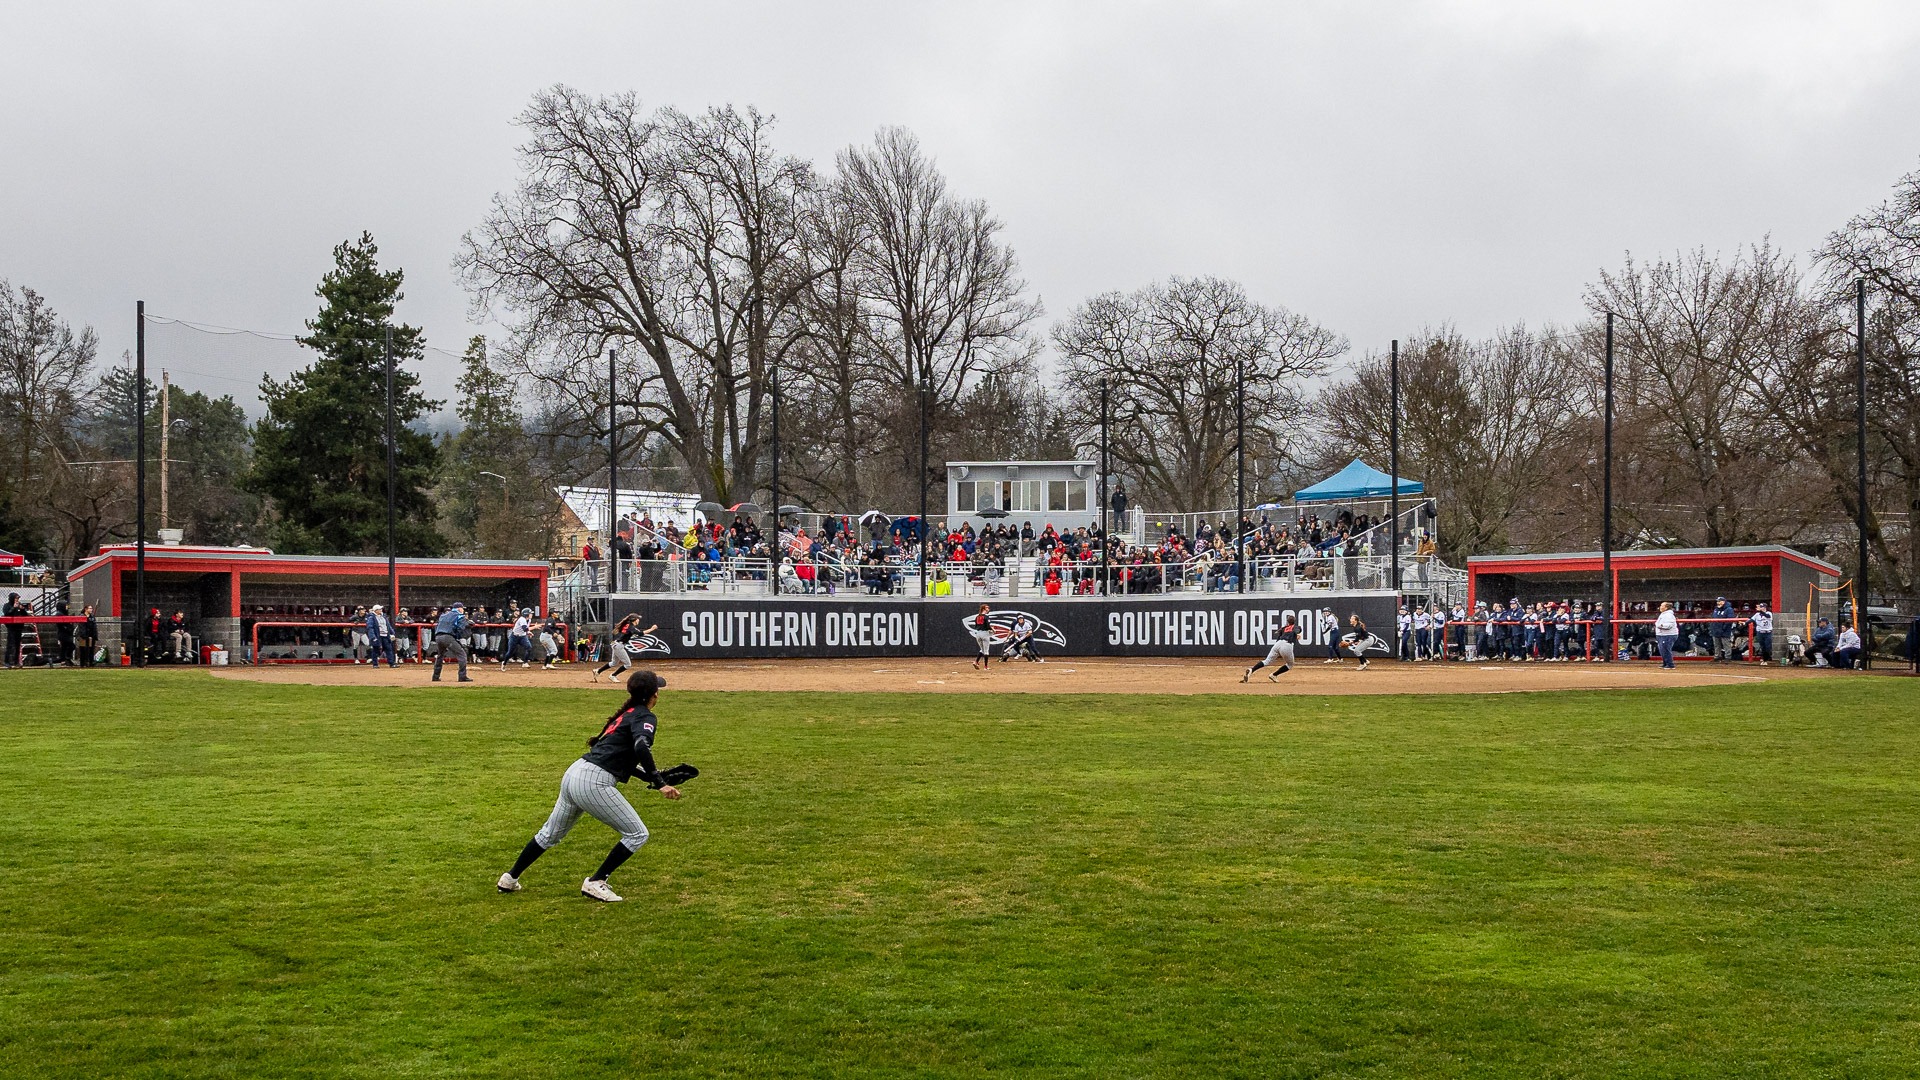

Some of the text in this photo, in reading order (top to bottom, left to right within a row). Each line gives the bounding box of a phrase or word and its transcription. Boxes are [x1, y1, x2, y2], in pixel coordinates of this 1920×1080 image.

[681, 611, 918, 647] SOUTHERN OREGON
[1108, 610, 1225, 646] SOUTHERN
